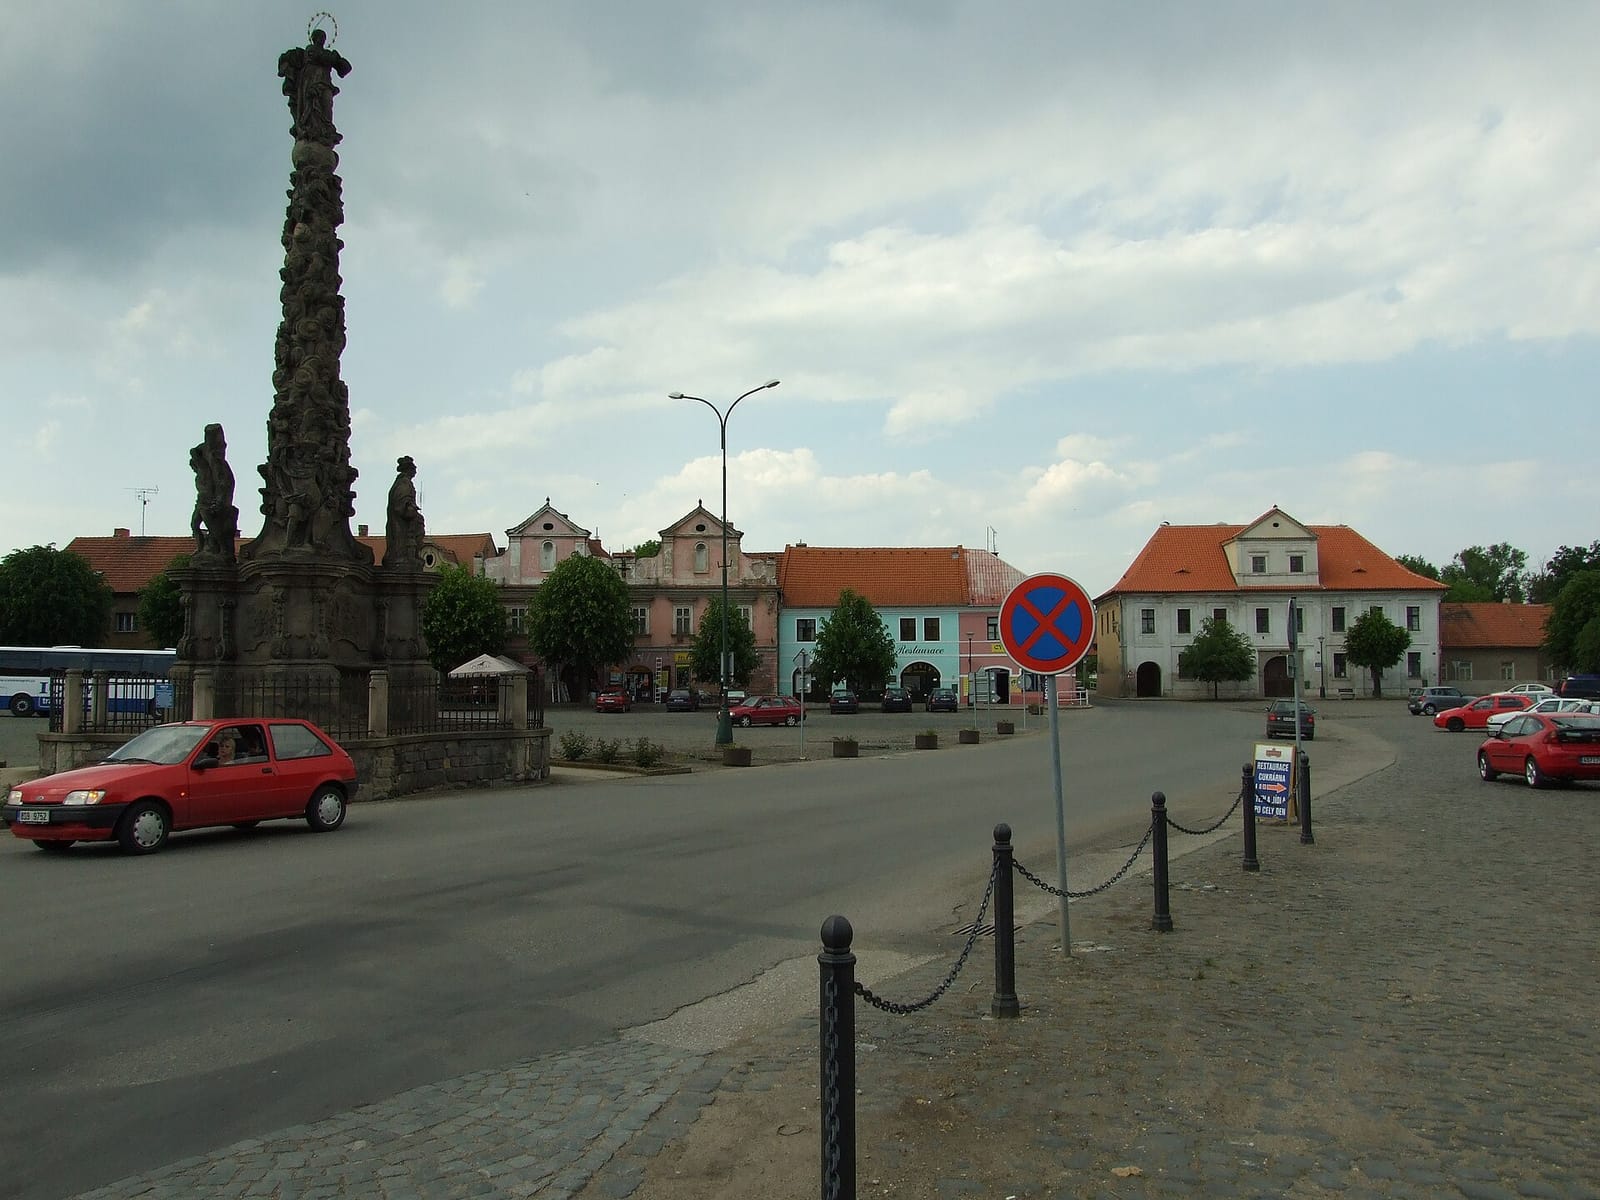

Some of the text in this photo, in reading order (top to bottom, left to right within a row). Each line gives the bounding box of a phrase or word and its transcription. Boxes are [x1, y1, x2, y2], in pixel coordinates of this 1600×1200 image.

[897, 645, 944, 655] Restaurace
[1257, 762, 1289, 772] RESTAURACE
[1275, 807, 1286, 816] DEN
